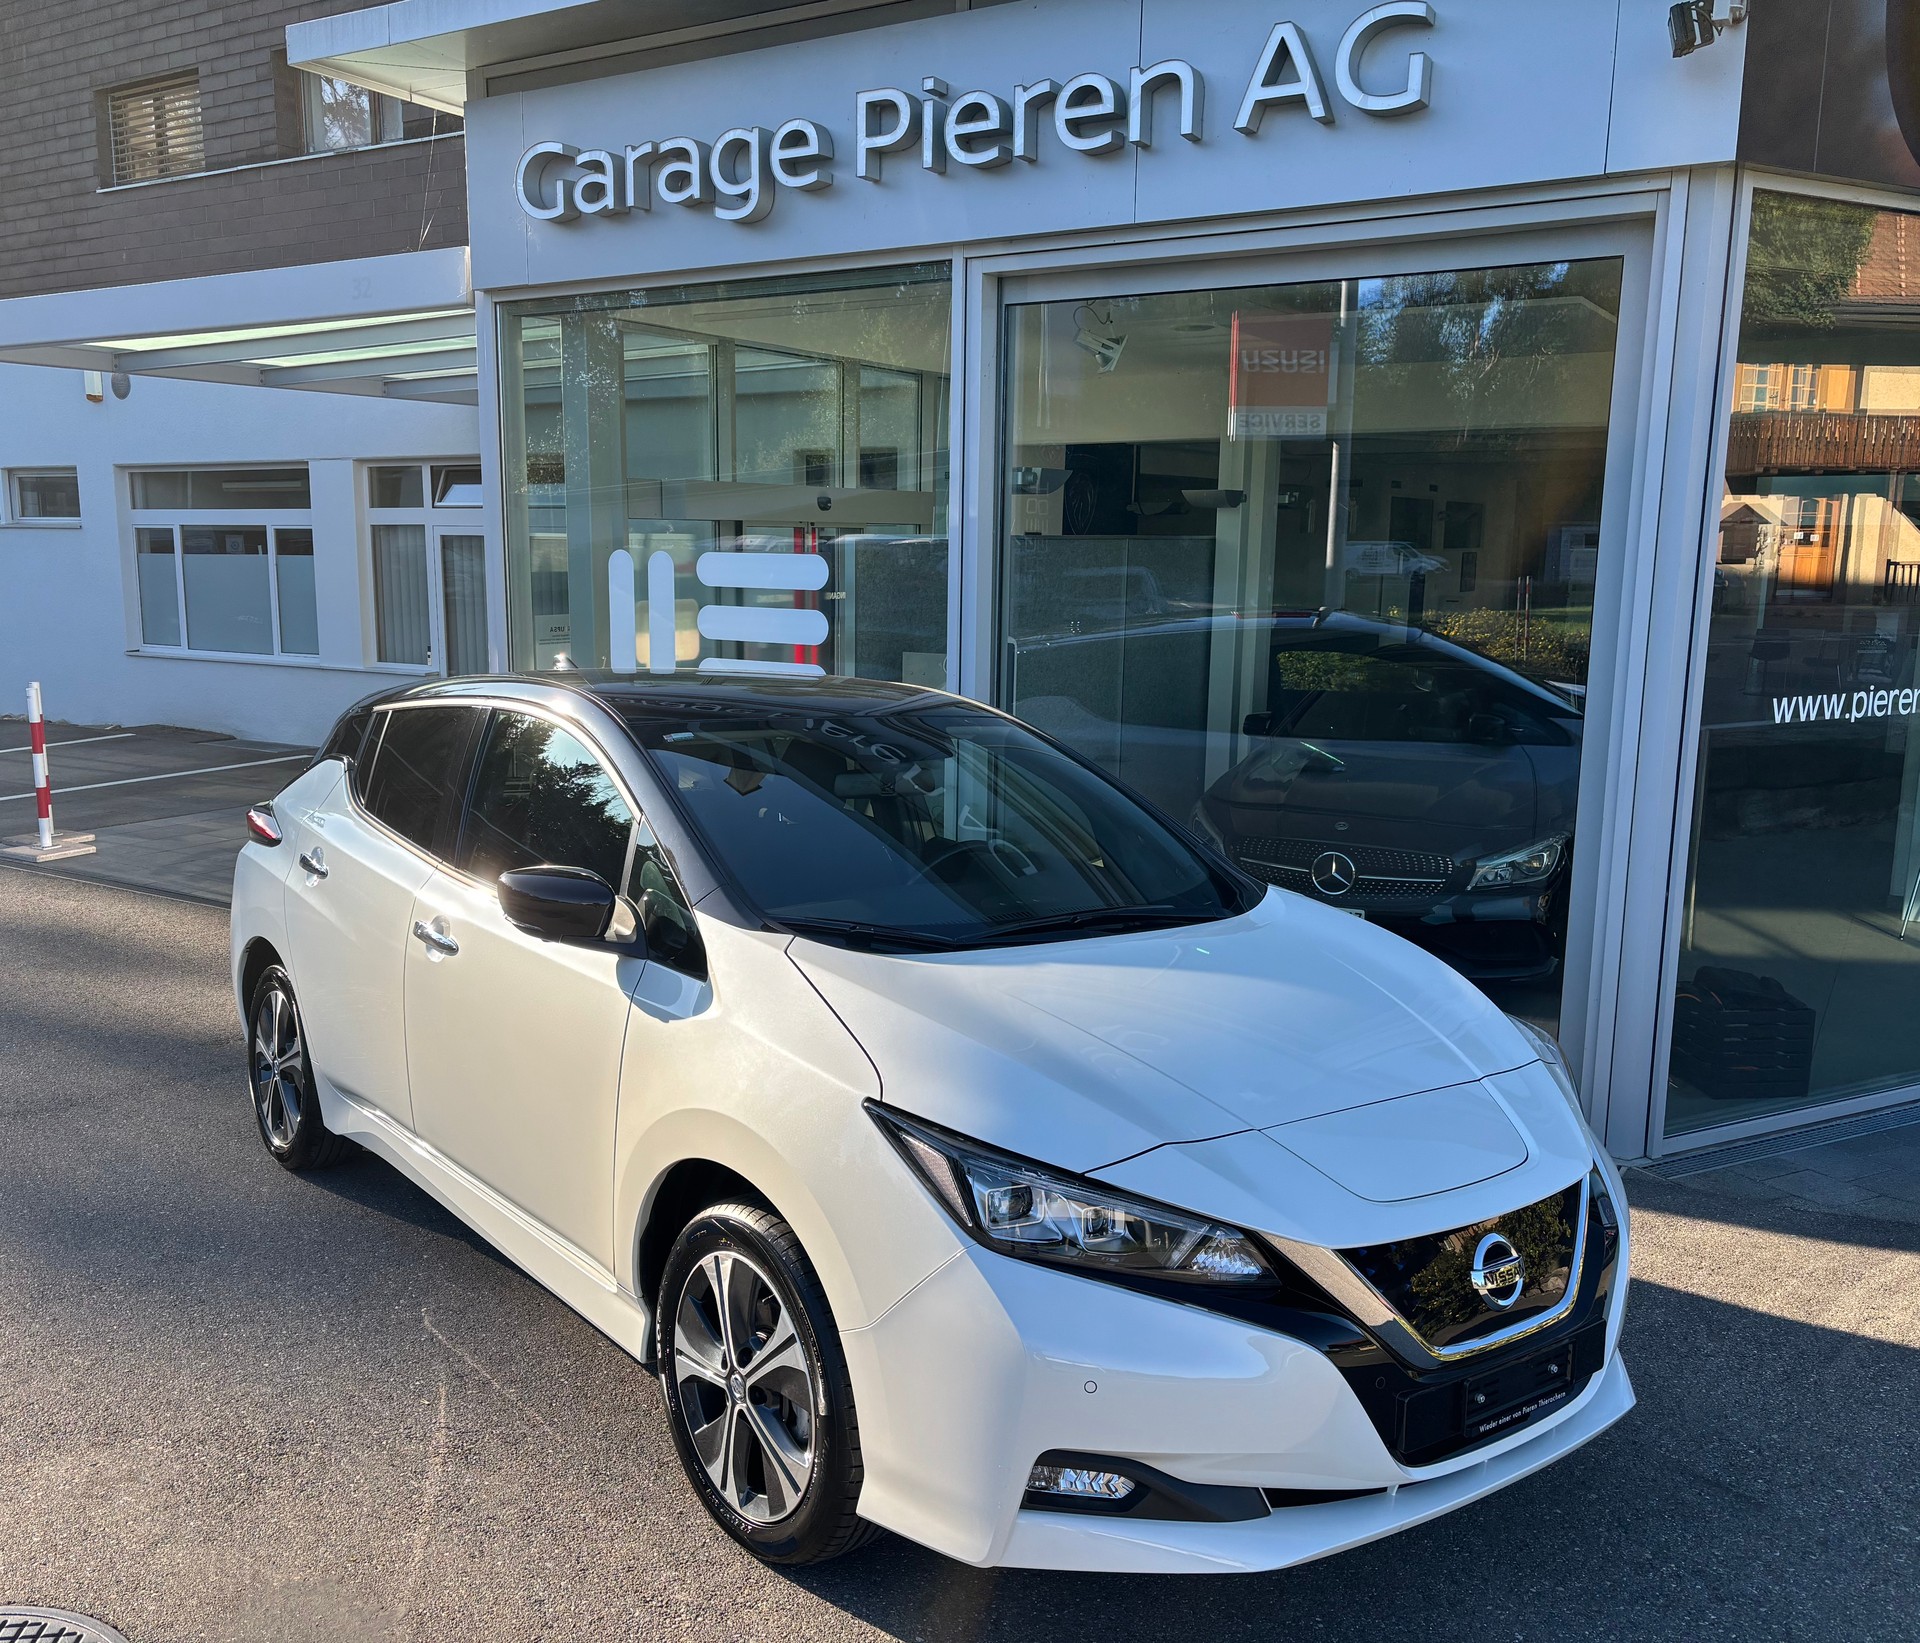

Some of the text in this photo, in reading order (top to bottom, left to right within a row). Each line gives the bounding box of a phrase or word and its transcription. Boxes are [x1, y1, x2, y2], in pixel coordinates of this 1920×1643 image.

[515, 1, 1436, 223] Garage Pieren AG
[351, 276, 373, 300] 32
[1479, 1419, 1498, 1433] Wieder
[1498, 1414, 1512, 1425] einer
[1512, 1410, 1522, 1419] von
[1522, 1404, 1538, 1415] Pieren
